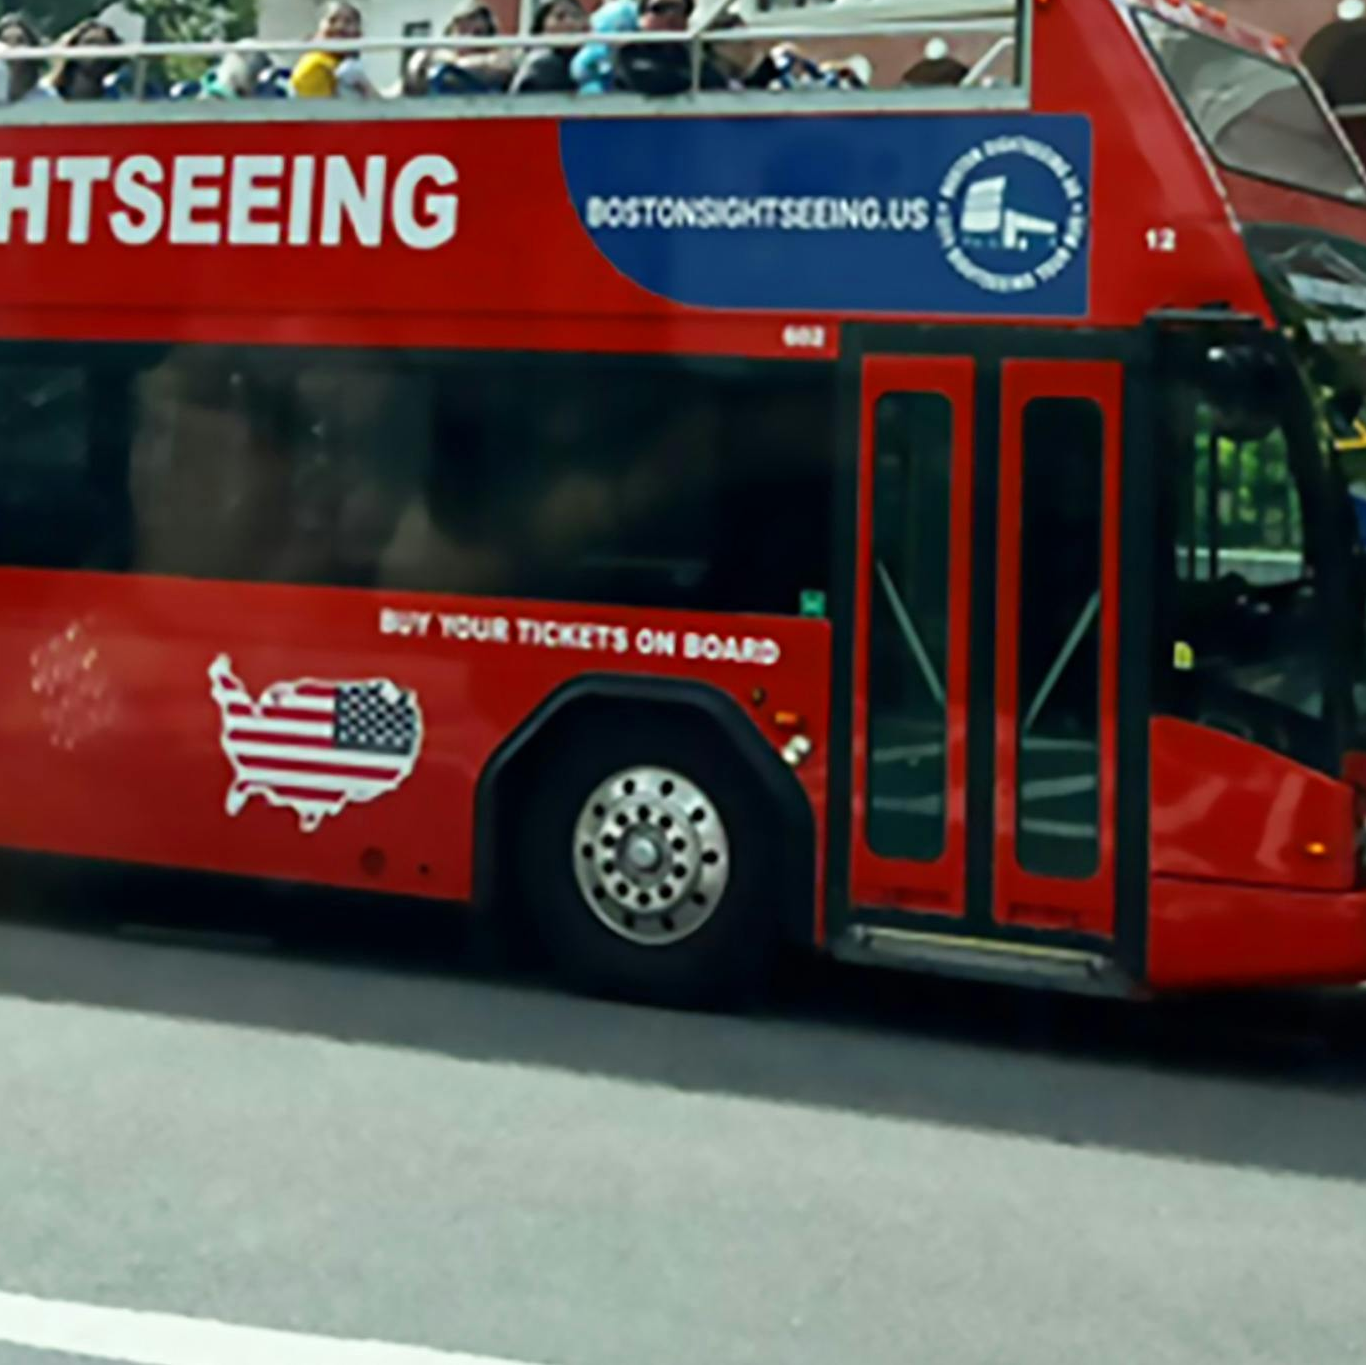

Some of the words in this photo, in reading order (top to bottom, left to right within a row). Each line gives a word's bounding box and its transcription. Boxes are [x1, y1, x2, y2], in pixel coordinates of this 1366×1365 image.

[587, 196, 928, 229] BOSTONSIGHTSEEING.US
[1146, 228, 1176, 252] 12
[379, 608, 431, 635] BUY
[439, 613, 509, 642] YOUR
[516, 619, 628, 653] TICKETS
[636, 628, 675, 656] ON
[683, 633, 780, 664] BOARD
